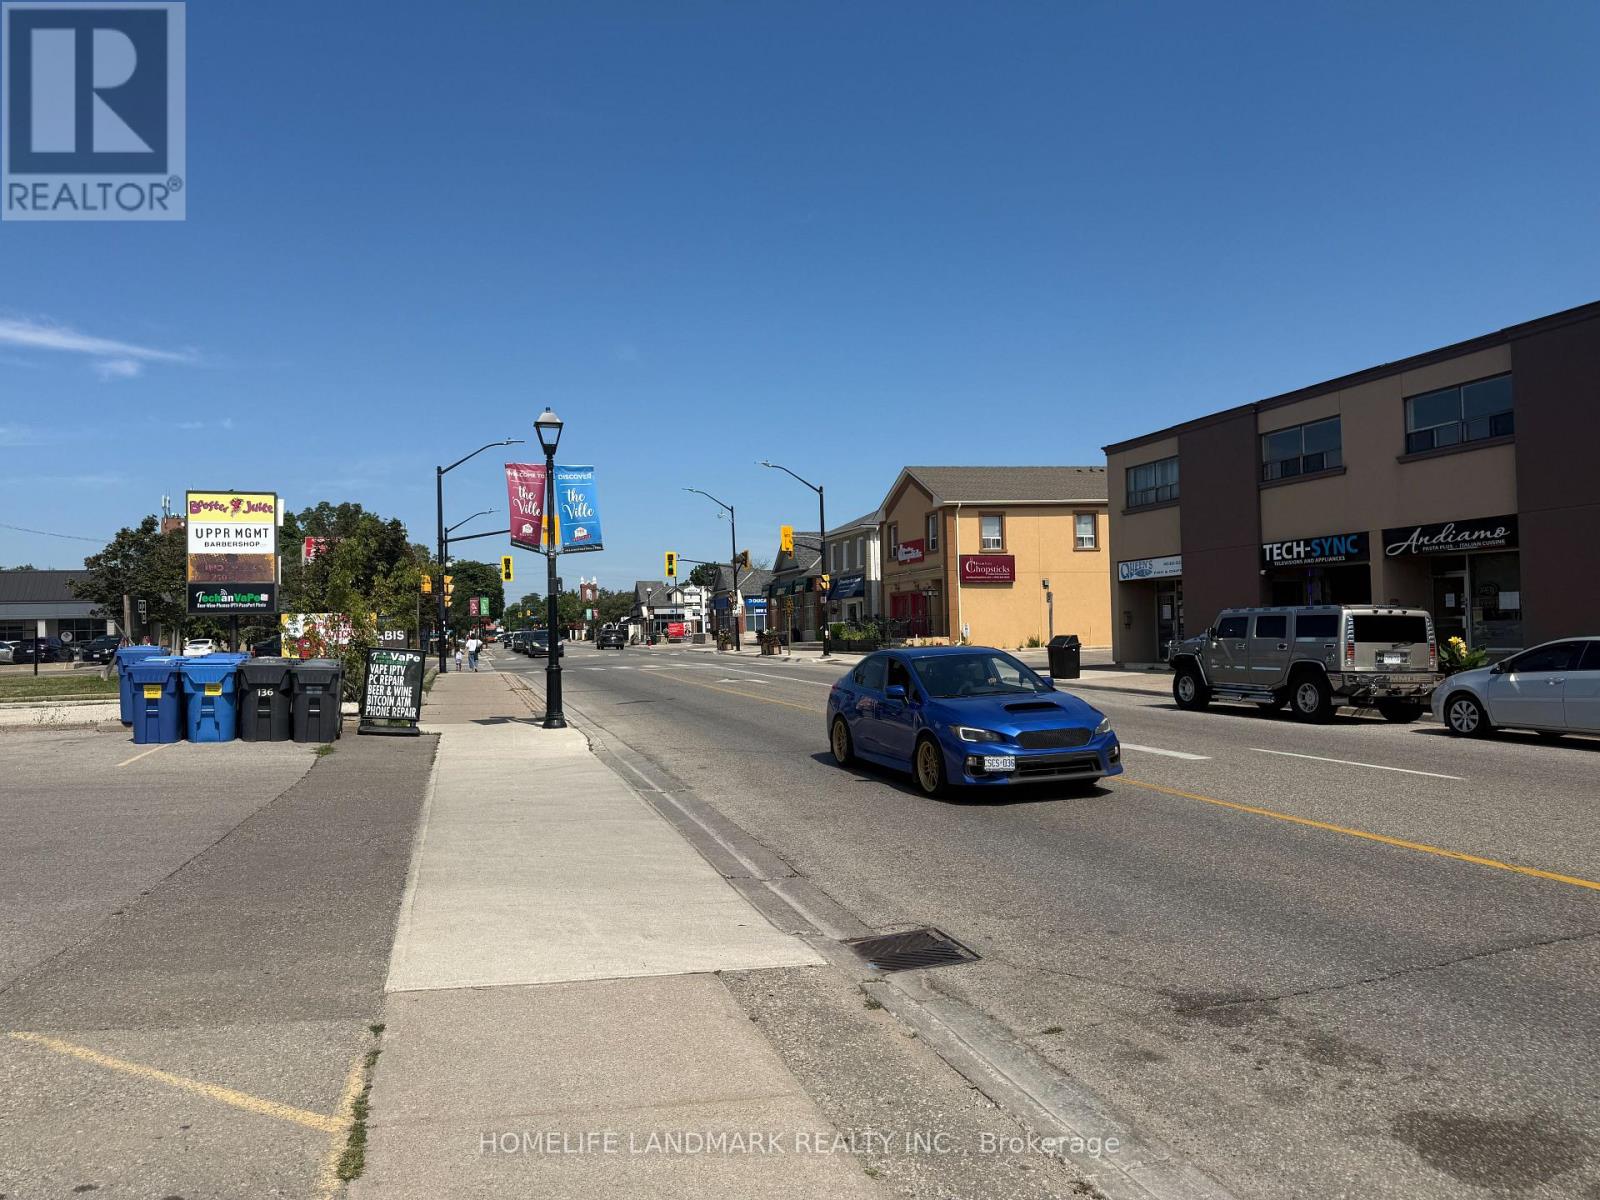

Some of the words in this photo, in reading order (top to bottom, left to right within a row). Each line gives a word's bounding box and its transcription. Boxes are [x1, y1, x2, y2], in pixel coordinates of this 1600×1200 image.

[557, 472, 592, 480] DISCOVER
[513, 485, 536, 500] the
[560, 488, 585, 502] the
[190, 500, 229, 514] Booster
[243, 501, 273, 514] Juice
[512, 495, 542, 517] Ville
[561, 502, 595, 520] Ville
[196, 528, 230, 538] UPPR
[236, 528, 269, 538] MGMT
[1385, 523, 1510, 556] Andiamo
[1262, 535, 1358, 561] TECH-SYNC
[966, 557, 1010, 575] Chopsticks
[1274, 558, 1304, 566] TELEVISIONS
[1120, 560, 1153, 579] QUEEN'S
[370, 664, 388, 675] VAPE
[389, 665, 406, 675] IPTV
[368, 674, 379, 684] PC
[380, 675, 405, 685] REPAIR
[256, 688, 274, 697] 136
[367, 685, 384, 696] BEER
[386, 686, 392, 695] &
[394, 686, 413, 697] WINE
[366, 696, 394, 707] BITCOIN
[396, 697, 411, 707] ATM
[365, 706, 390, 717] PHONE
[391, 707, 417, 718] REPAIR
